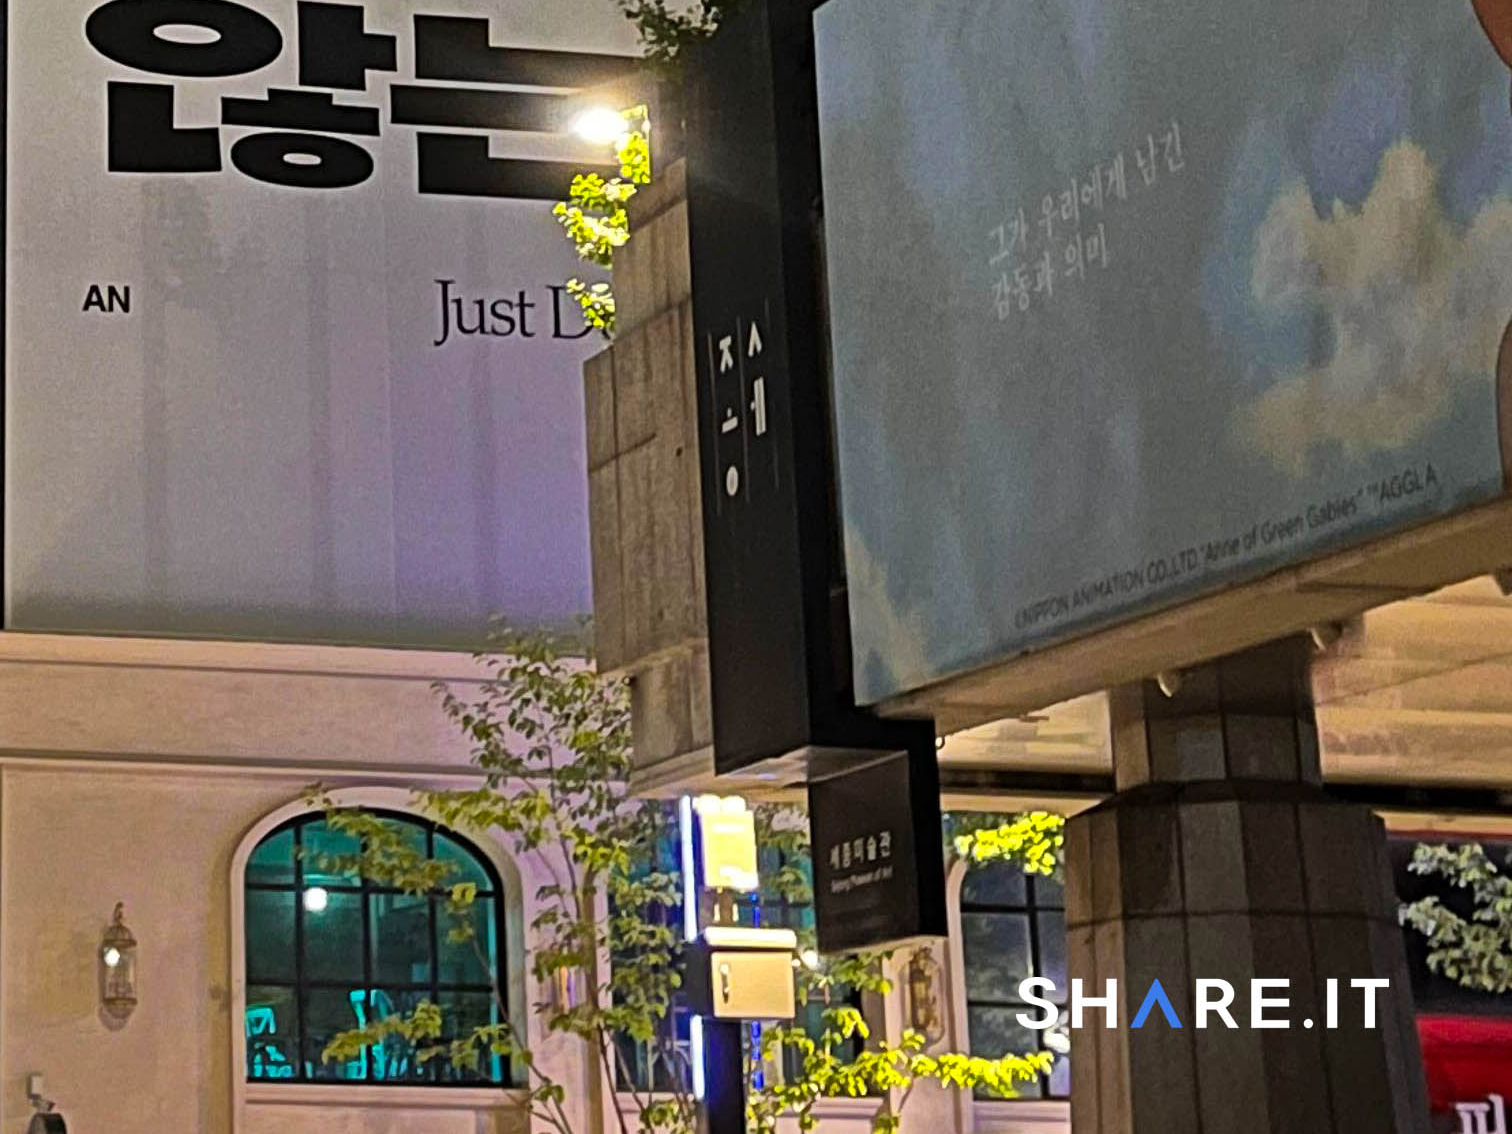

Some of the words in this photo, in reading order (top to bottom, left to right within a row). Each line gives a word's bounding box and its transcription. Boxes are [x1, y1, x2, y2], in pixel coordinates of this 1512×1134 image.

[990, 207, 1028, 265] 그가
[1039, 153, 1127, 238] 우리에게
[1136, 122, 1185, 187] 남긴
[1065, 223, 1108, 282] 의미
[83, 284, 131, 313] AN
[434, 279, 536, 346] Just
[546, 285, 612, 340] D
